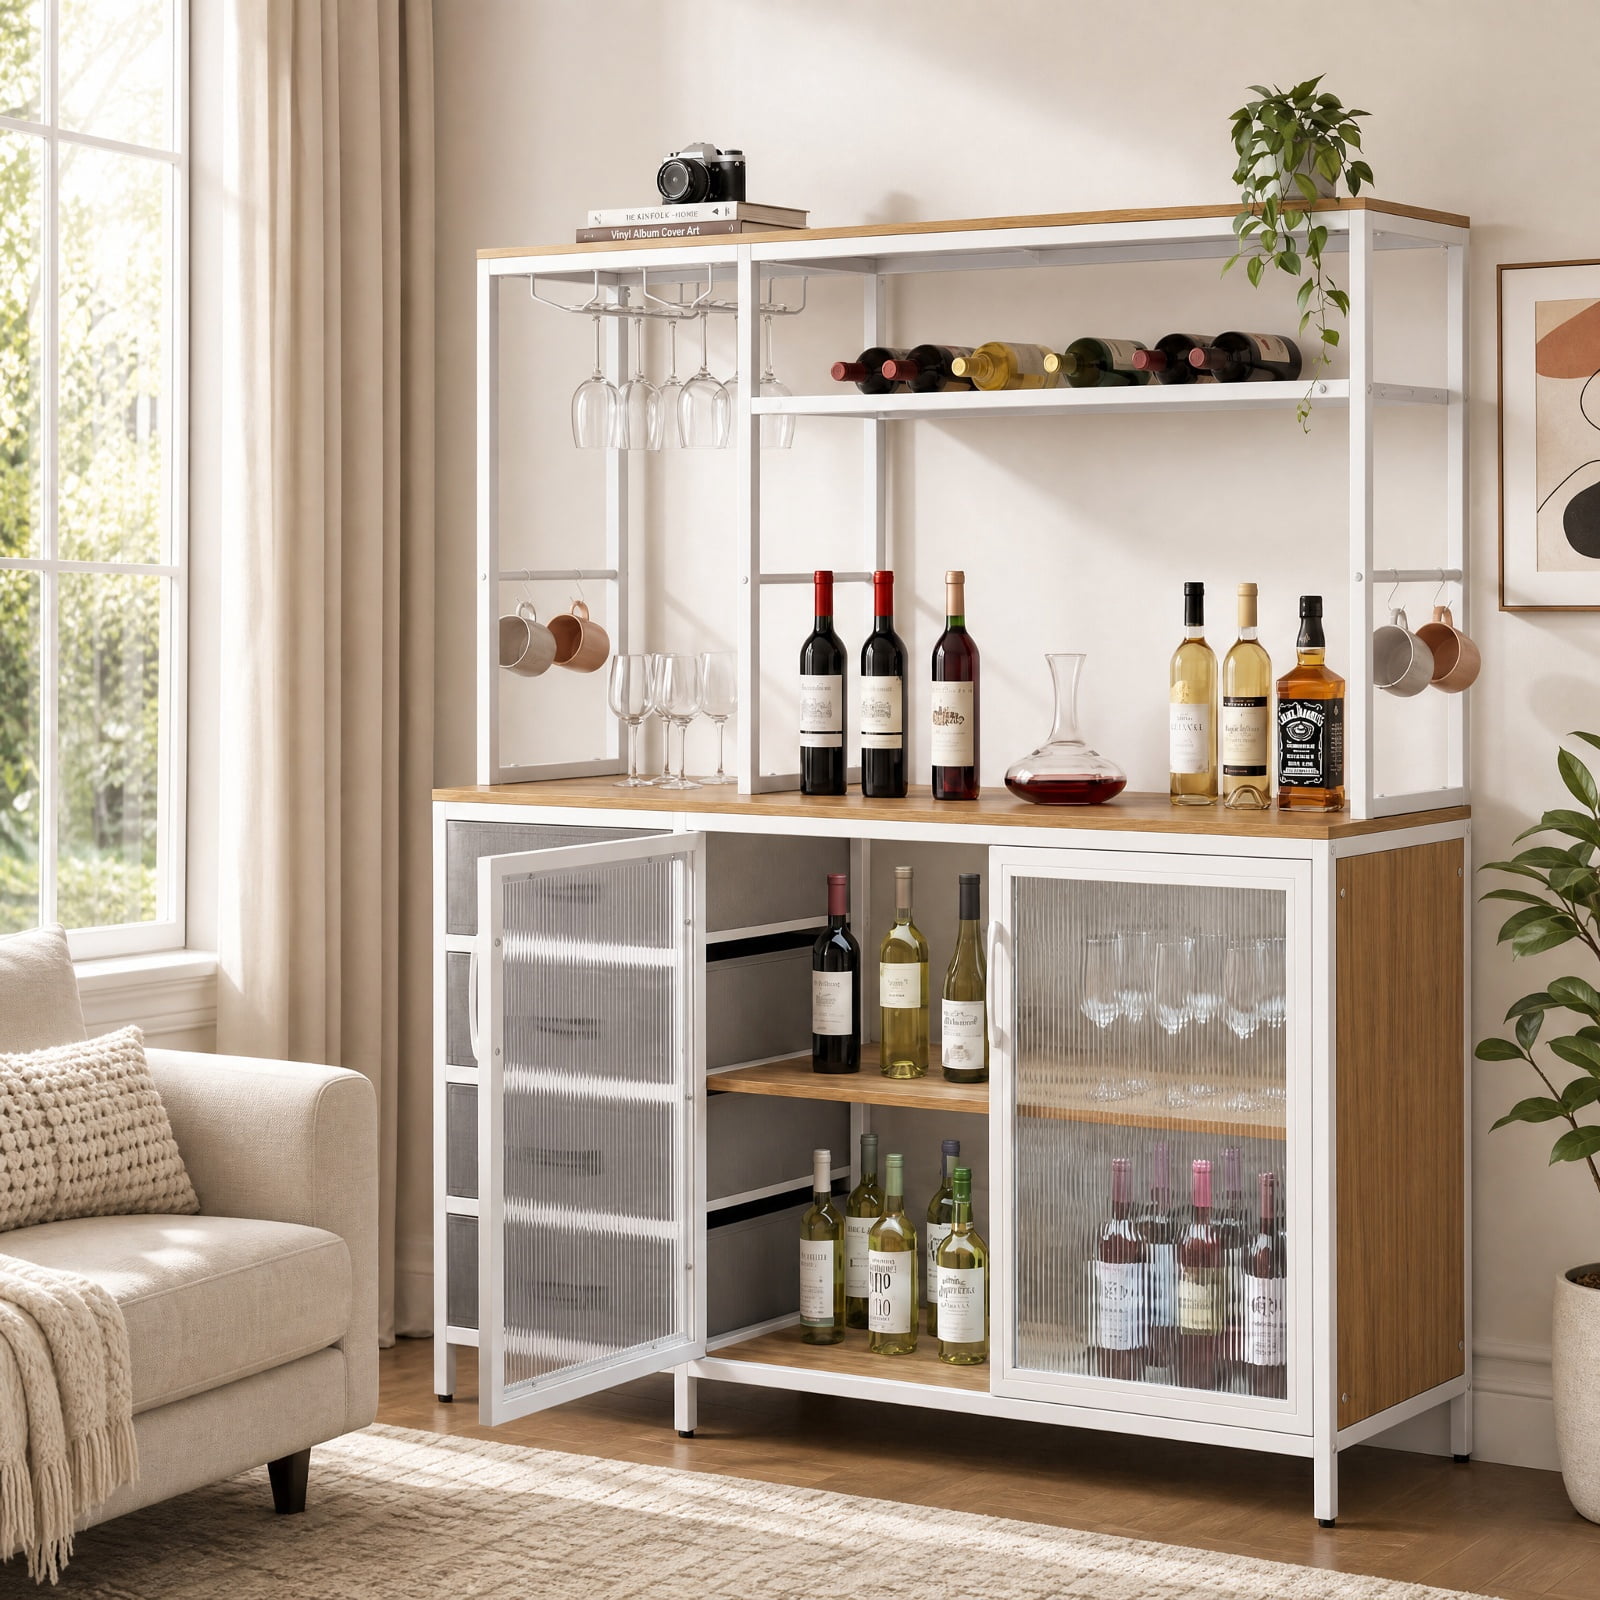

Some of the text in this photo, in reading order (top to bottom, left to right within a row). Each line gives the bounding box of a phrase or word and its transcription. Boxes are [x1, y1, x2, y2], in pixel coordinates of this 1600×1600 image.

[611, 225, 700, 241] Vinyl Album Cover Art
